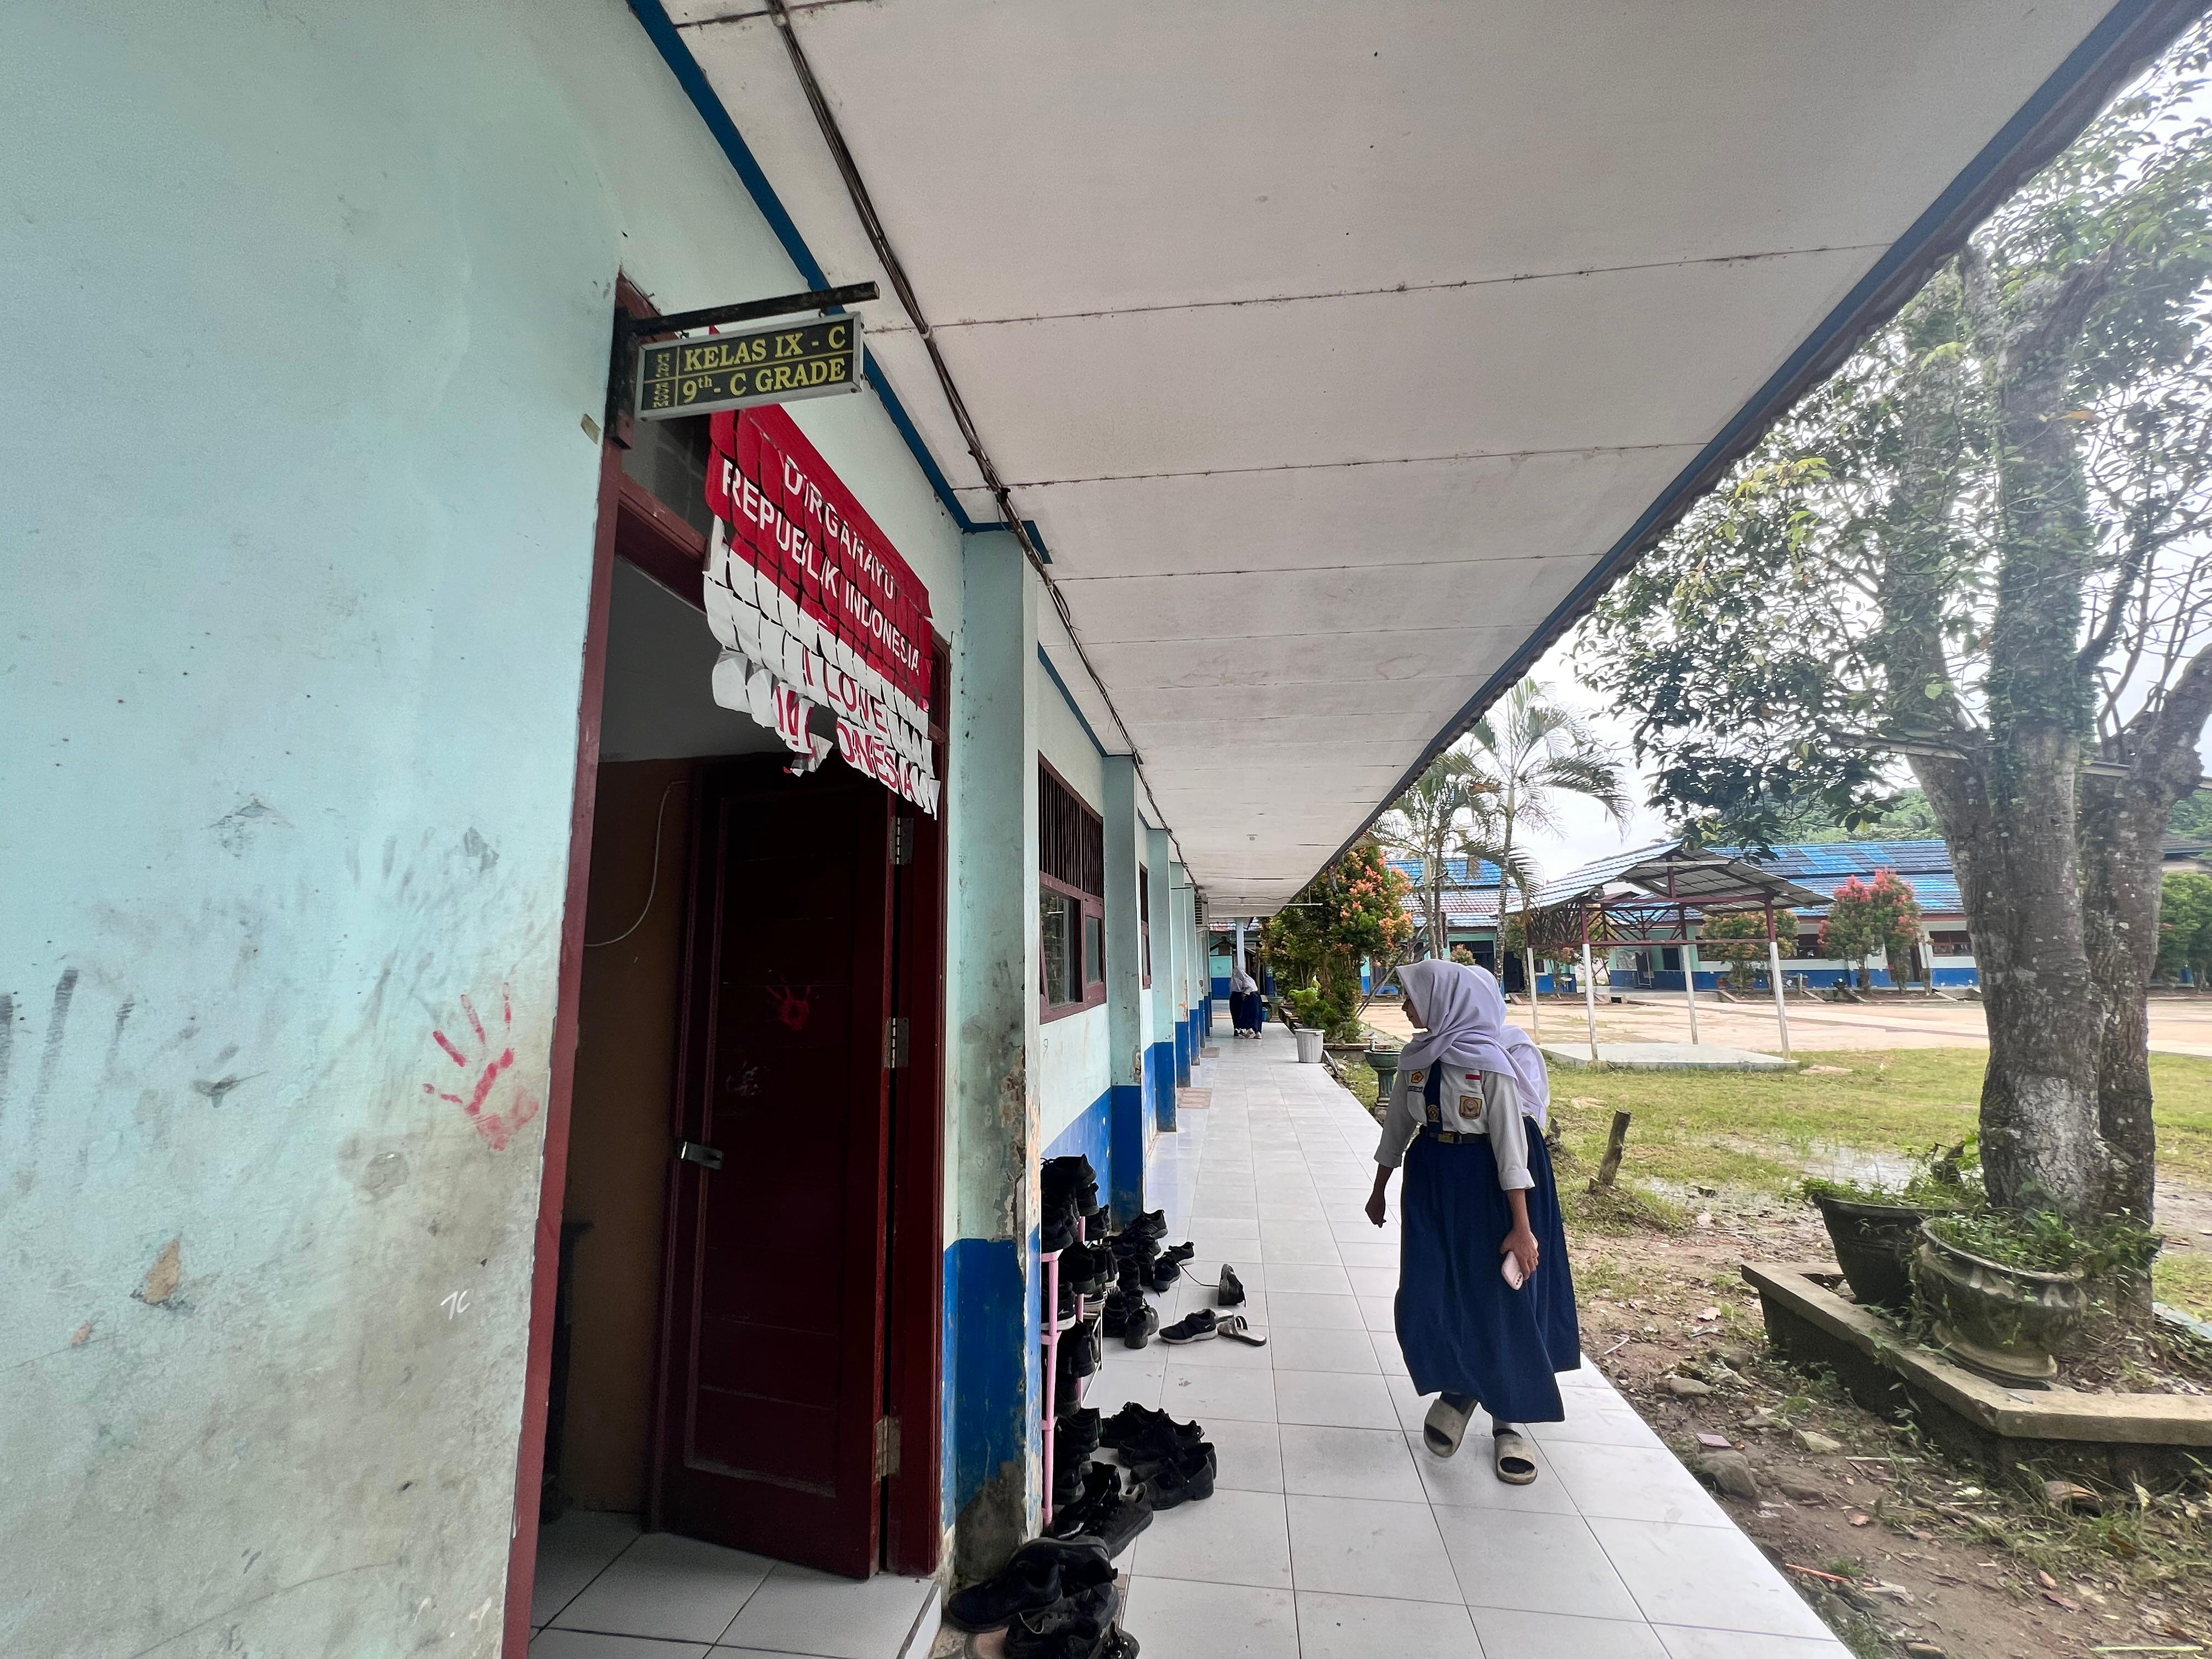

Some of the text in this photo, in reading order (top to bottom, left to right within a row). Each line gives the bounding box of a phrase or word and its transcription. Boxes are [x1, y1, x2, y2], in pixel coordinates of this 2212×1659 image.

[684, 338, 766, 371] KELAS
[775, 332, 804, 358] IX
[828, 325, 846, 349] C
[730, 373, 747, 397] C
[754, 358, 846, 393] GRADE
[785, 454, 894, 600] DIRGAHAYU
[845, 579, 919, 676] INDONESIA
[804, 646, 814, 686] I
